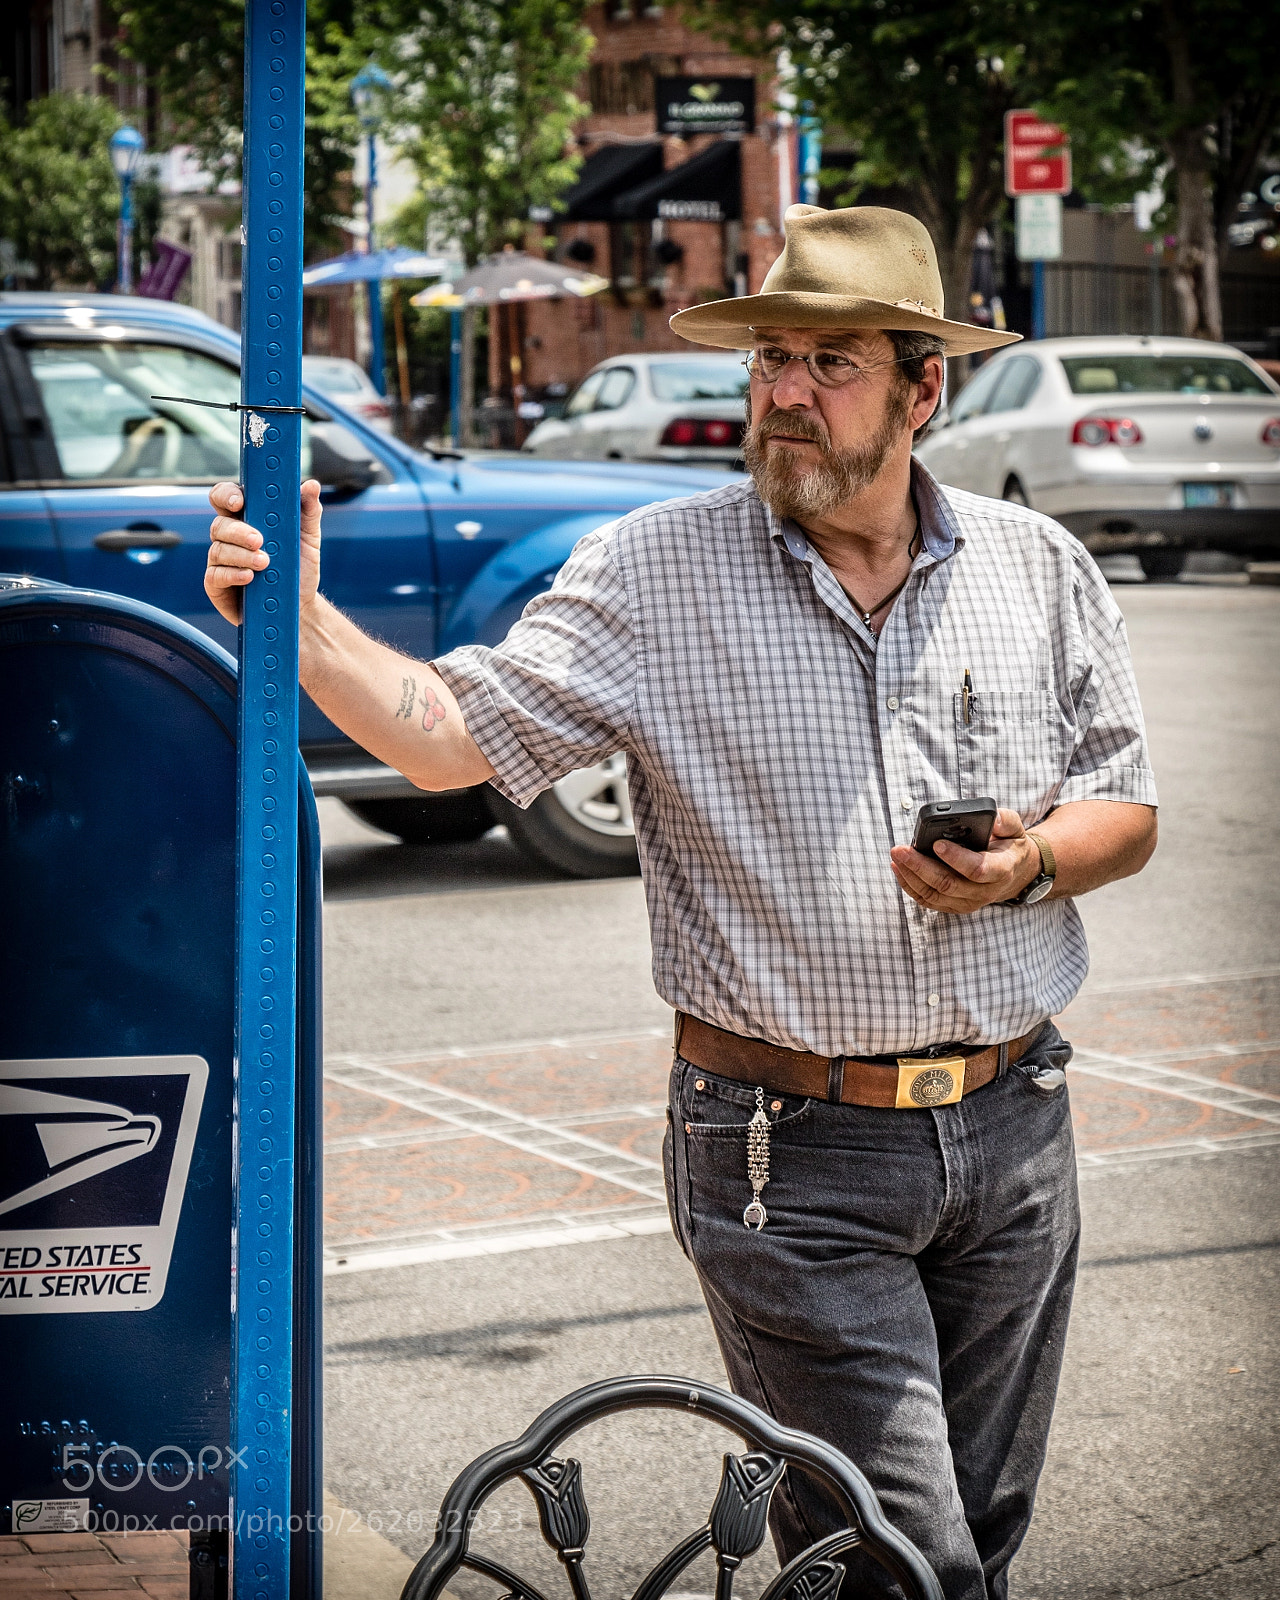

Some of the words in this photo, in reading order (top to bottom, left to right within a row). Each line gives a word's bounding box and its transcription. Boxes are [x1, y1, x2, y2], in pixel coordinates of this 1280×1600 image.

[0, 1246, 42, 1269] ED
[46, 1244, 142, 1267] STATES
[0, 1276, 33, 1298] AL
[39, 1273, 150, 1297] SERVICE
